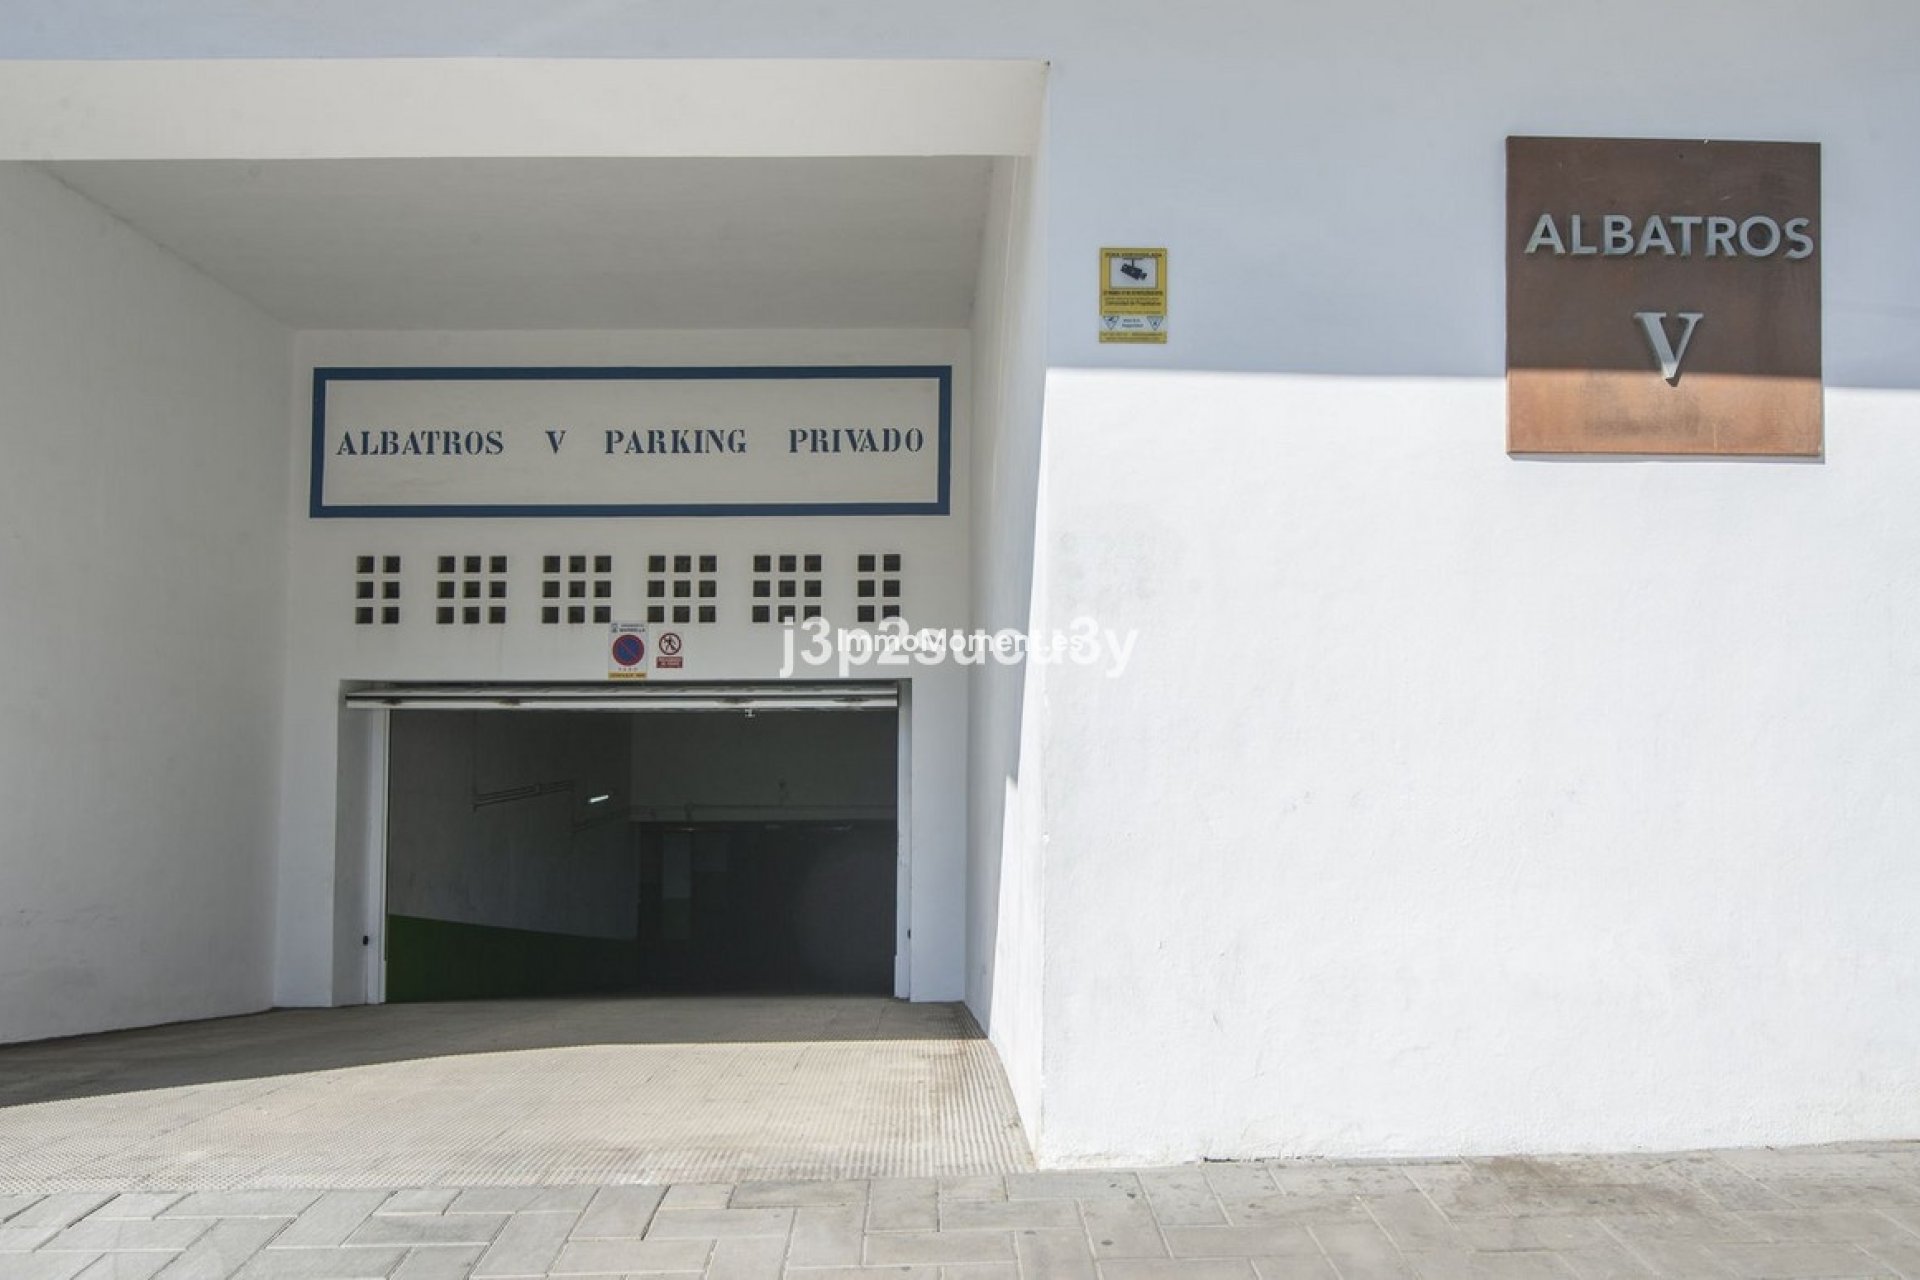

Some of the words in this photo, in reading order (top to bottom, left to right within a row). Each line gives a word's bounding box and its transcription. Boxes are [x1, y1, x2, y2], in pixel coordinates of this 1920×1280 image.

[1524, 212, 1815, 260] ALBATROS
[1633, 311, 1704, 380] V
[335, 430, 505, 456] ALBATROS
[545, 429, 567, 455] V
[604, 429, 747, 454] PARKING
[788, 427, 924, 453] PRIVADO
